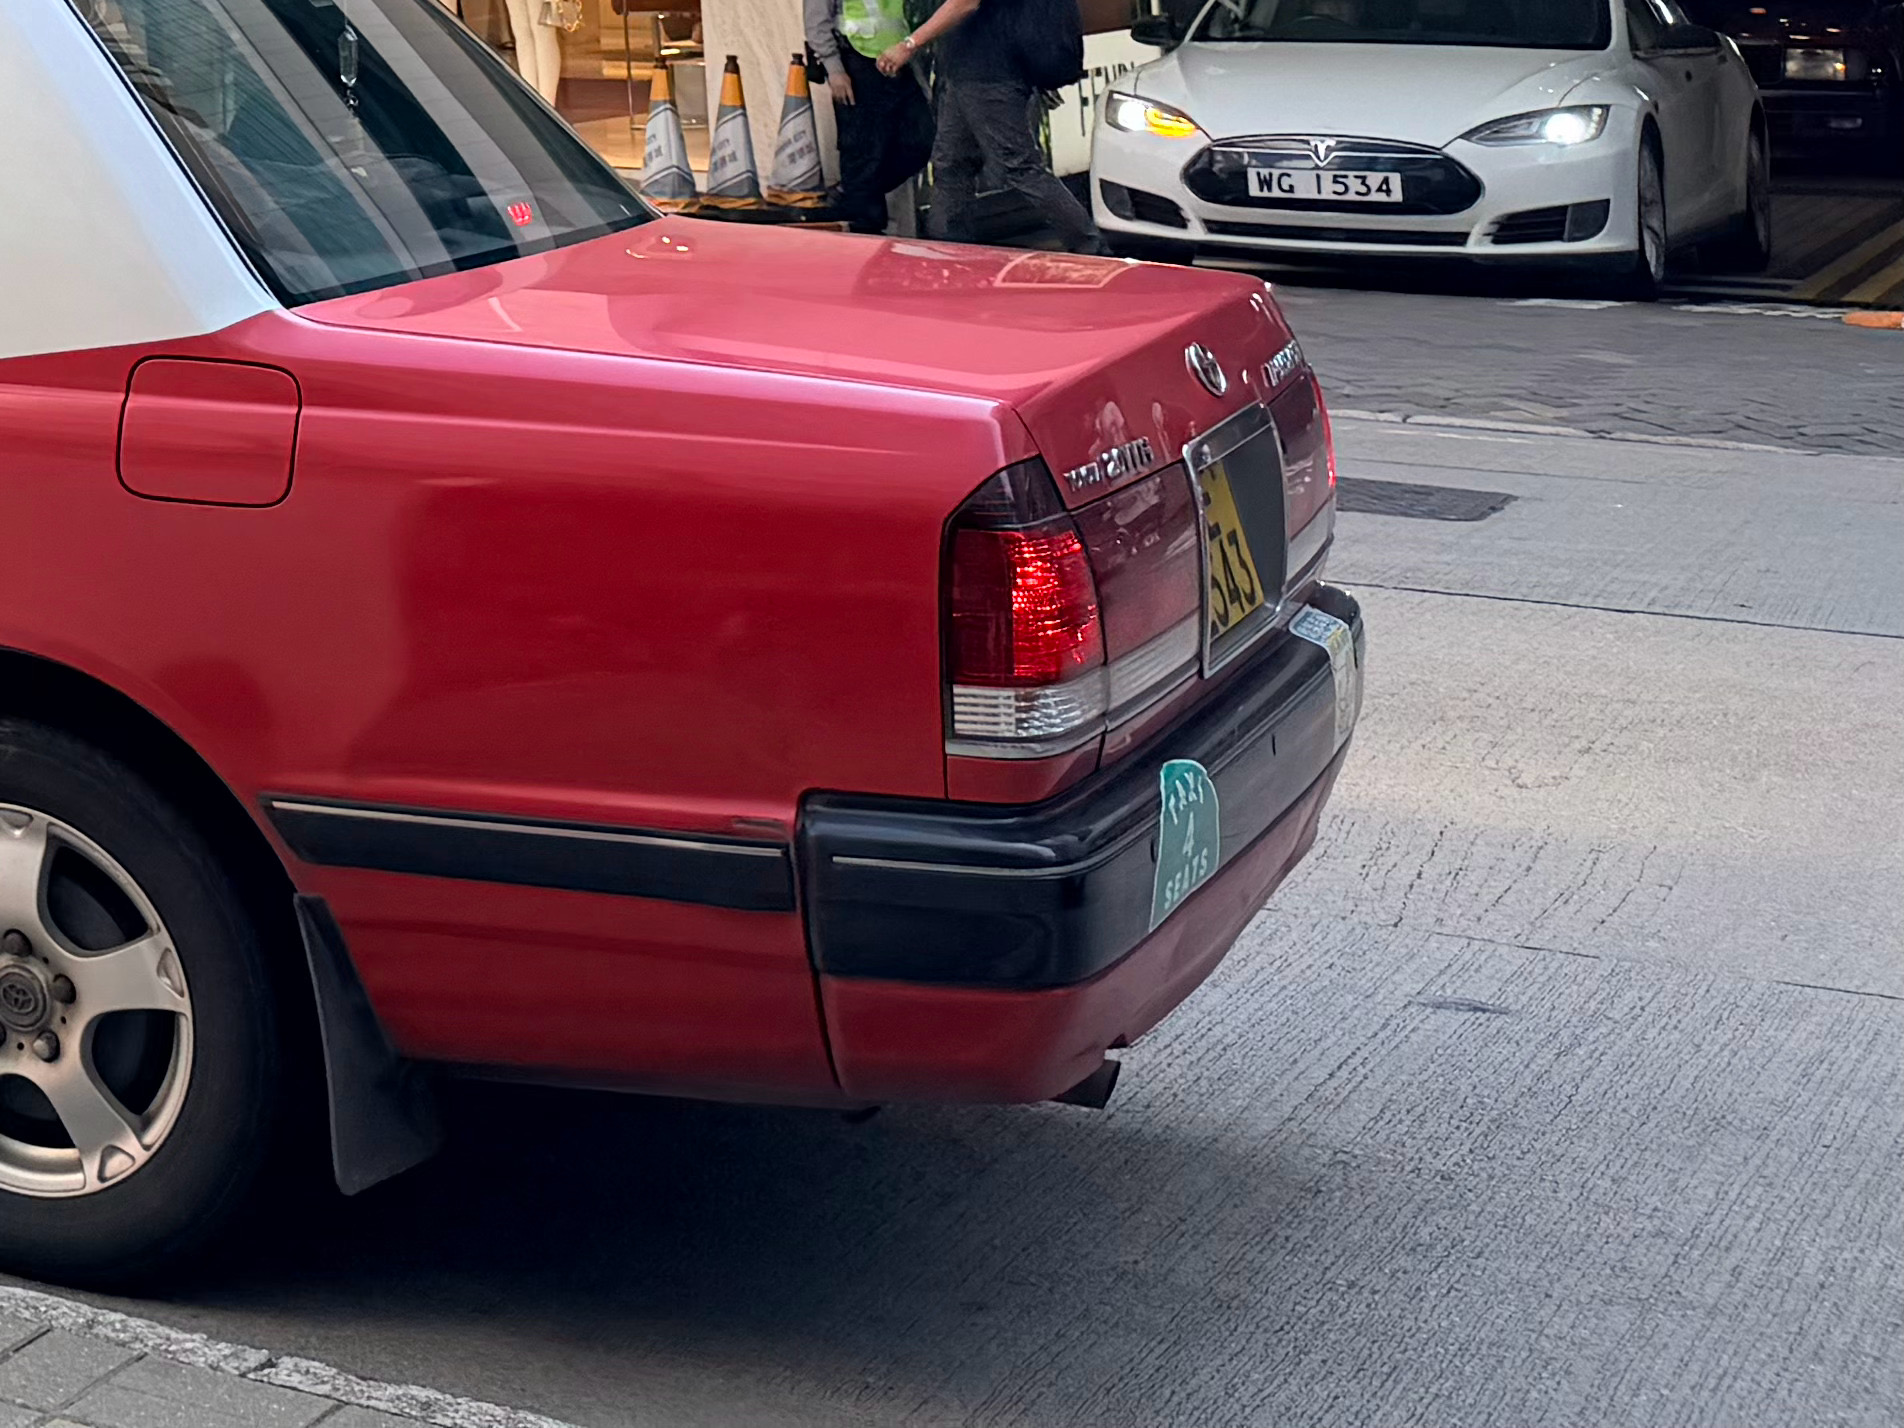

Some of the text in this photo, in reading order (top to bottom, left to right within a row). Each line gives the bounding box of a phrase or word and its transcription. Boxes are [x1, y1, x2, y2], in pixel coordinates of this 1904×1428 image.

[1256, 171, 1391, 197] WG 1534
[1168, 771, 1204, 826] TAXI
[1182, 811, 1195, 858] 4
[1164, 847, 1208, 910] SEATS
